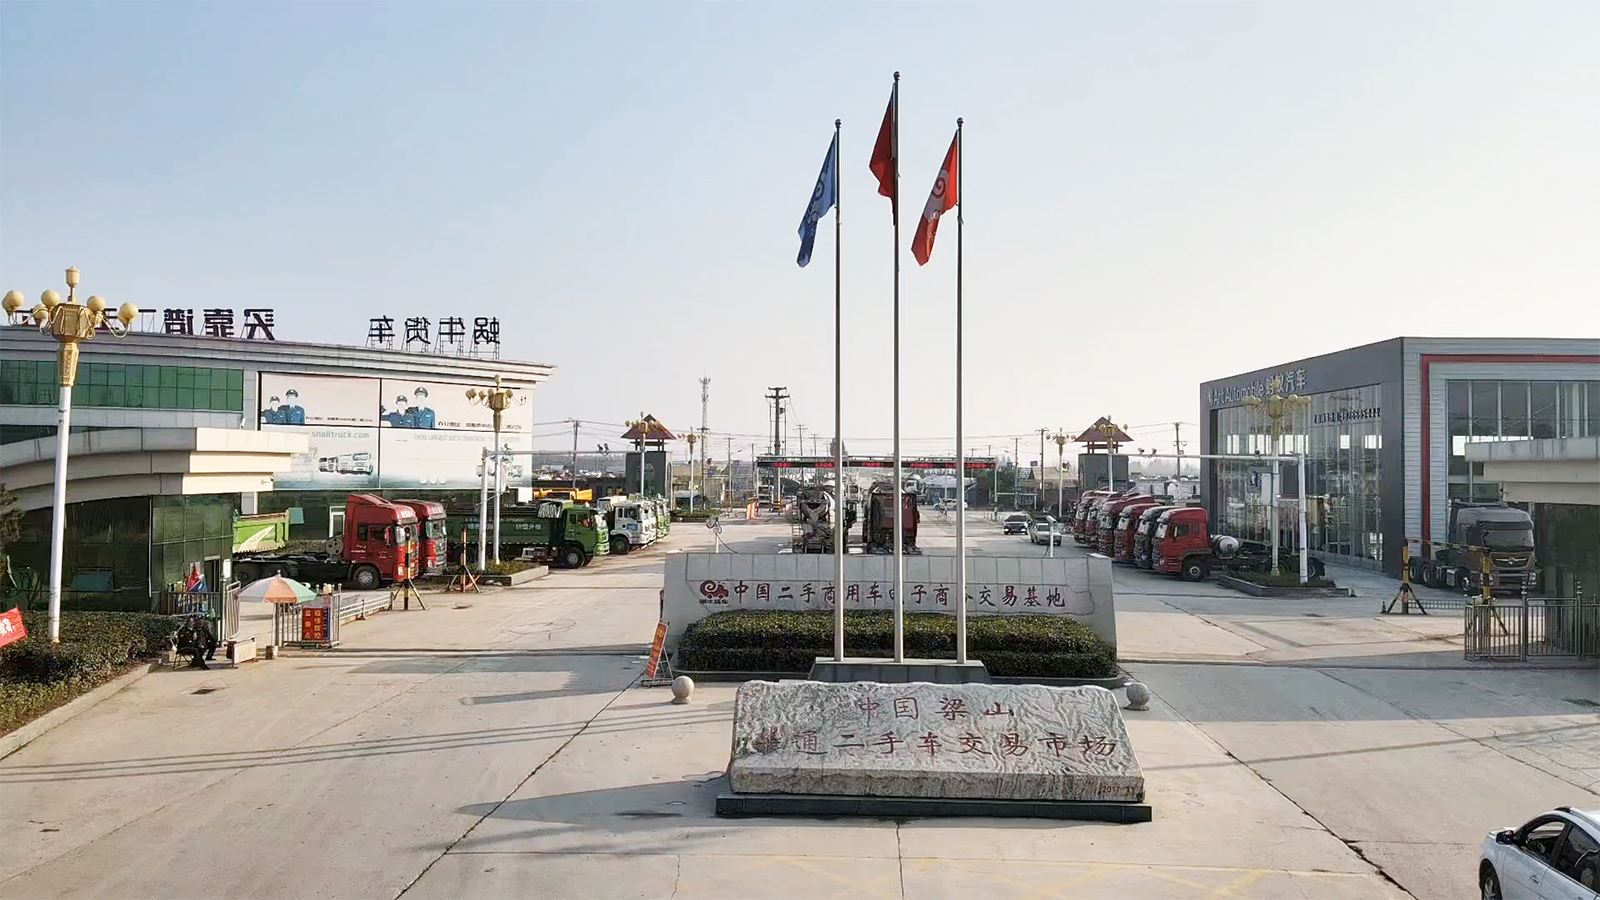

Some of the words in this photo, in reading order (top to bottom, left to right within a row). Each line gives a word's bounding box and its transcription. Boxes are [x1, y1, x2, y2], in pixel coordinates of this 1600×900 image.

[288, 430, 370, 439] .snailtruck.com
[734, 581, 1066, 607] 中国二手商用车子商交易基地
[859, 696, 1014, 723] 中国梁山
